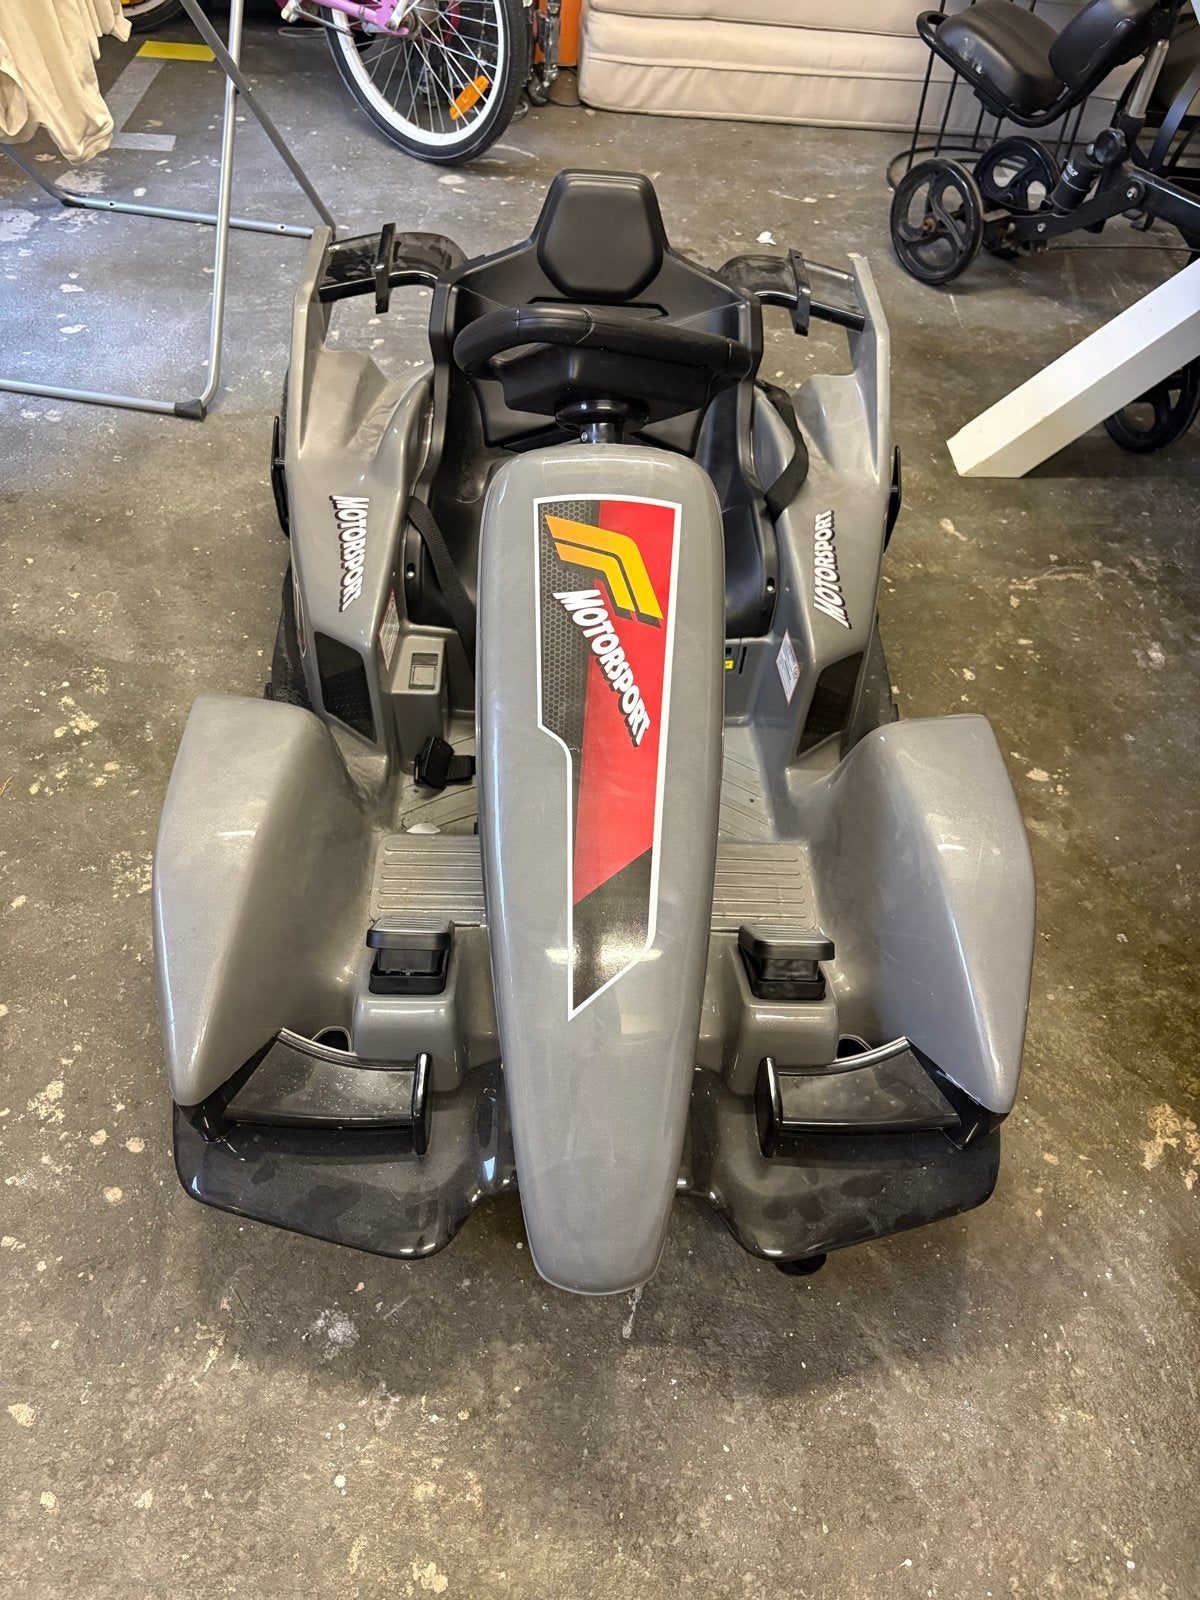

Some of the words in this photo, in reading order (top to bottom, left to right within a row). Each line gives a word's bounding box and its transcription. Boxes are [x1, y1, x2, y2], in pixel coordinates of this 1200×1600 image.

[330, 495, 370, 612] MOTORSPORT
[813, 510, 852, 629] MOTORSPORT
[552, 589, 651, 746] MOTORSPORT
